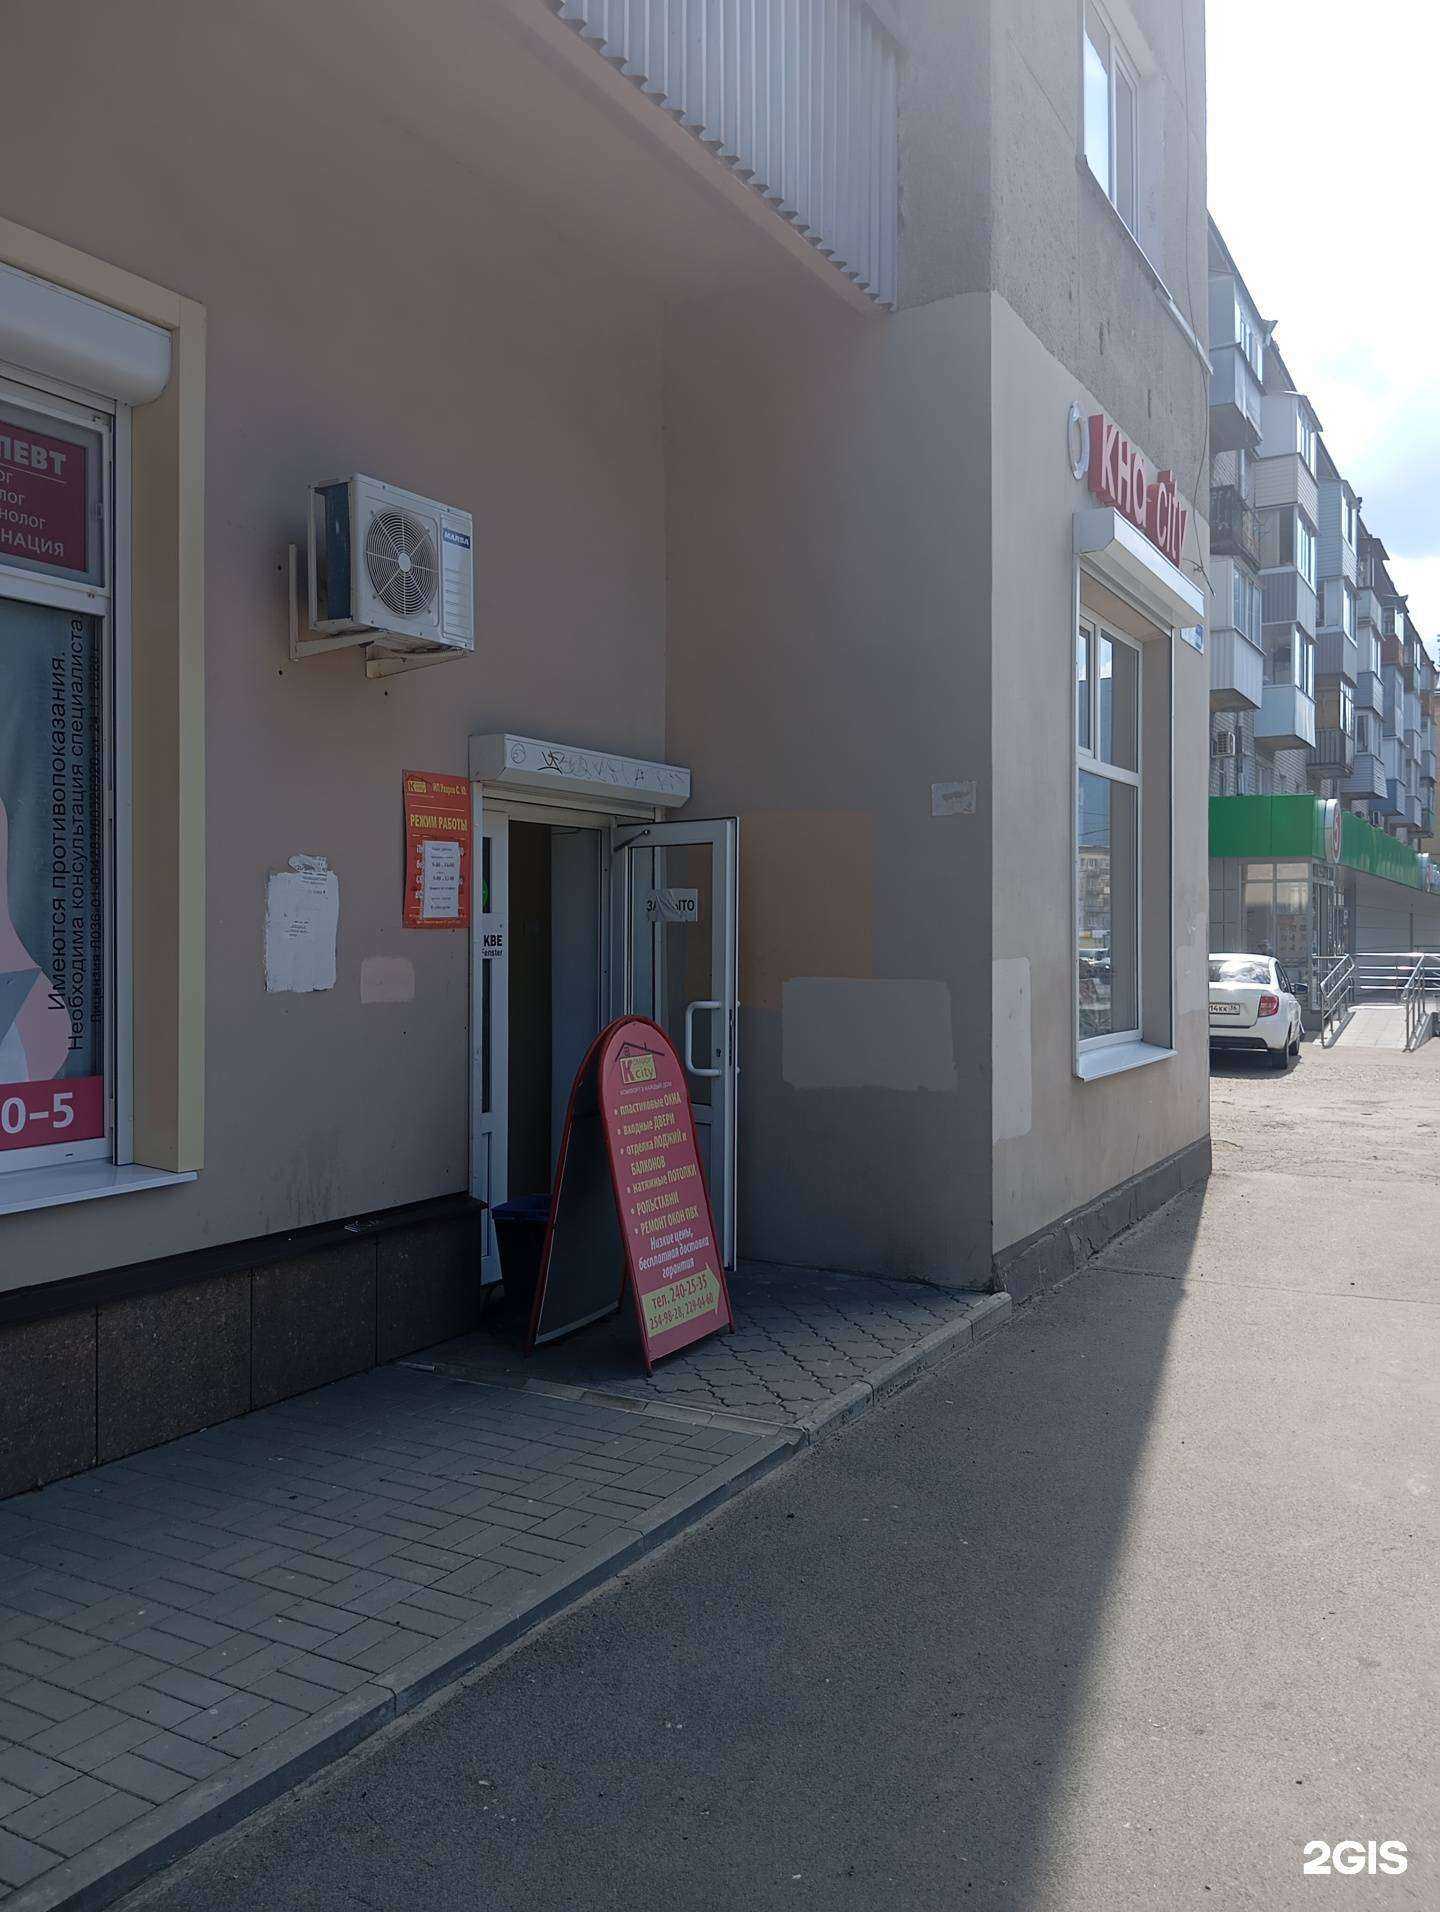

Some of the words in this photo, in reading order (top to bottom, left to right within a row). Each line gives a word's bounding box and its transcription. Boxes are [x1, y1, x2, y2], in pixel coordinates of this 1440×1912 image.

[1, 529, 65, 557] НАЦИЯ
[52, 652, 70, 889] противопоказания.
[410, 813, 437, 828] РЕЖИМ
[438, 816, 468, 832] РАБОТЫ
[72, 764, 88, 909] консультация
[47, 899, 66, 1010] Имеются
[68, 917, 87, 1050] Необходима
[639, 1215, 667, 1236] РЕМОНТ
